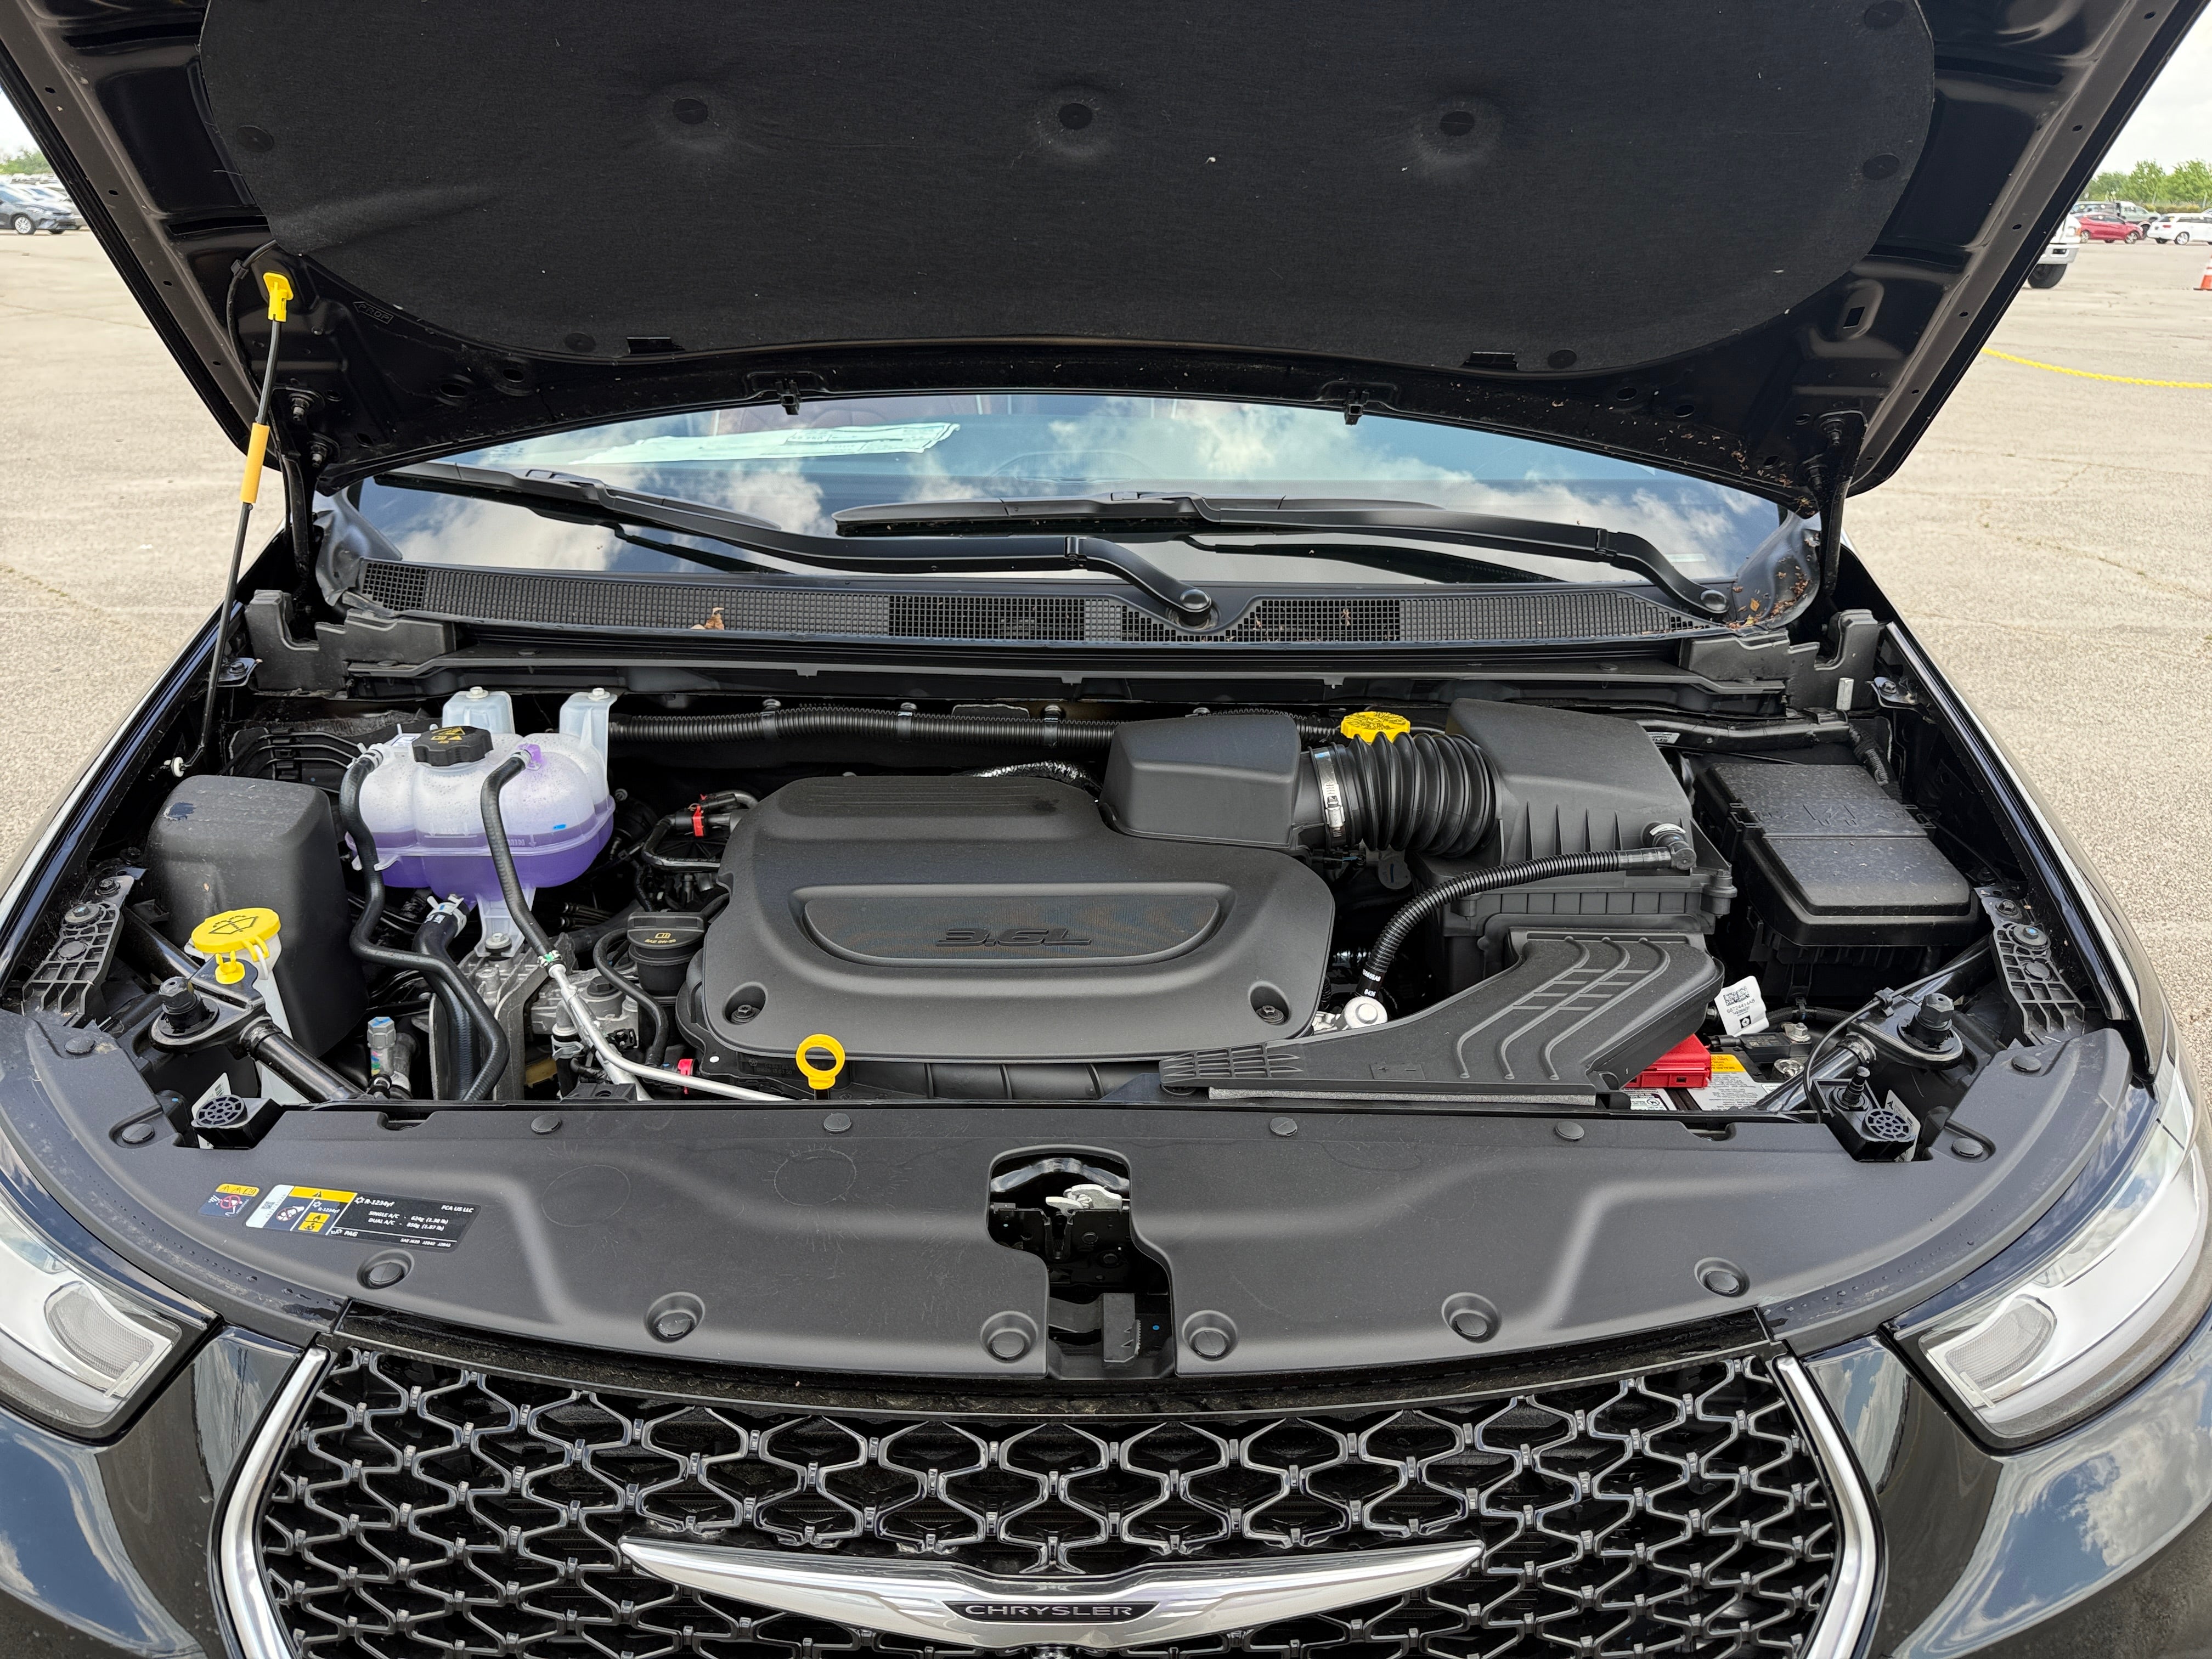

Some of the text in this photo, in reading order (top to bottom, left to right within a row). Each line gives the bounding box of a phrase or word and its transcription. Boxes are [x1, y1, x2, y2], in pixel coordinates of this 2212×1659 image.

[358, 303, 389, 319] PROP
[936, 928, 1092, 947] 3.6L
[364, 1199, 395, 1207] R-1234yf
[965, 1605, 1132, 1616] CHRYSLER
